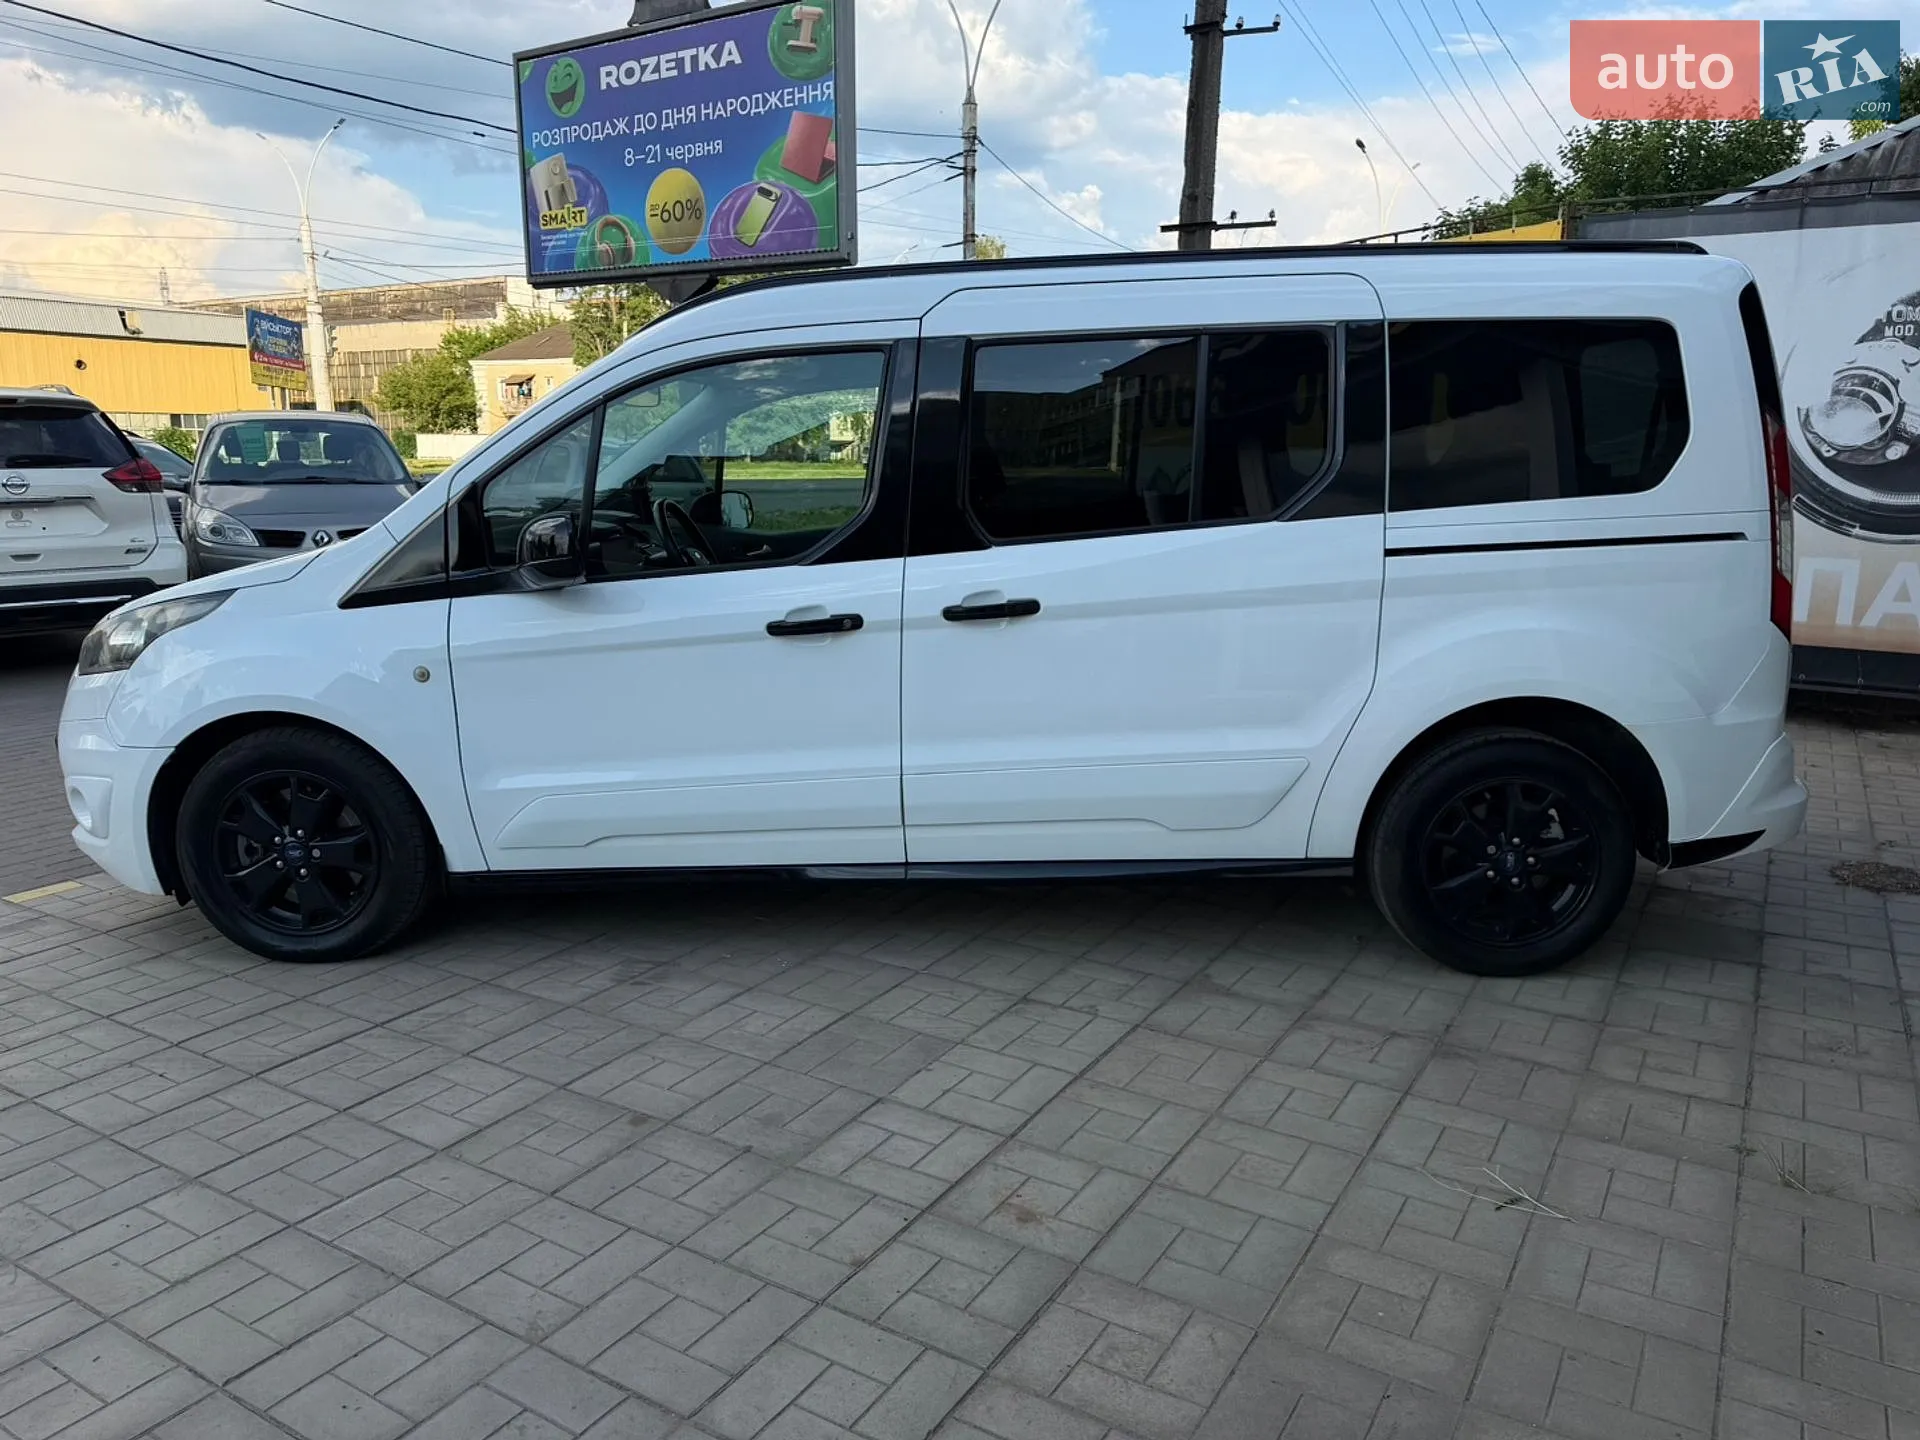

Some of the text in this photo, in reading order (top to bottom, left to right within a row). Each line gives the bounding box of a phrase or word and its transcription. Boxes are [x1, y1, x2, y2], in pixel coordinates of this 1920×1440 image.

[600, 40, 743, 90] ROZETKA
[531, 80, 834, 149] РОЗПРОДАЖ ДО ДНЯ НАРОДЖЕННЯ
[666, 139, 723, 164] червня
[1884, 324, 1918, 337] MOD.
